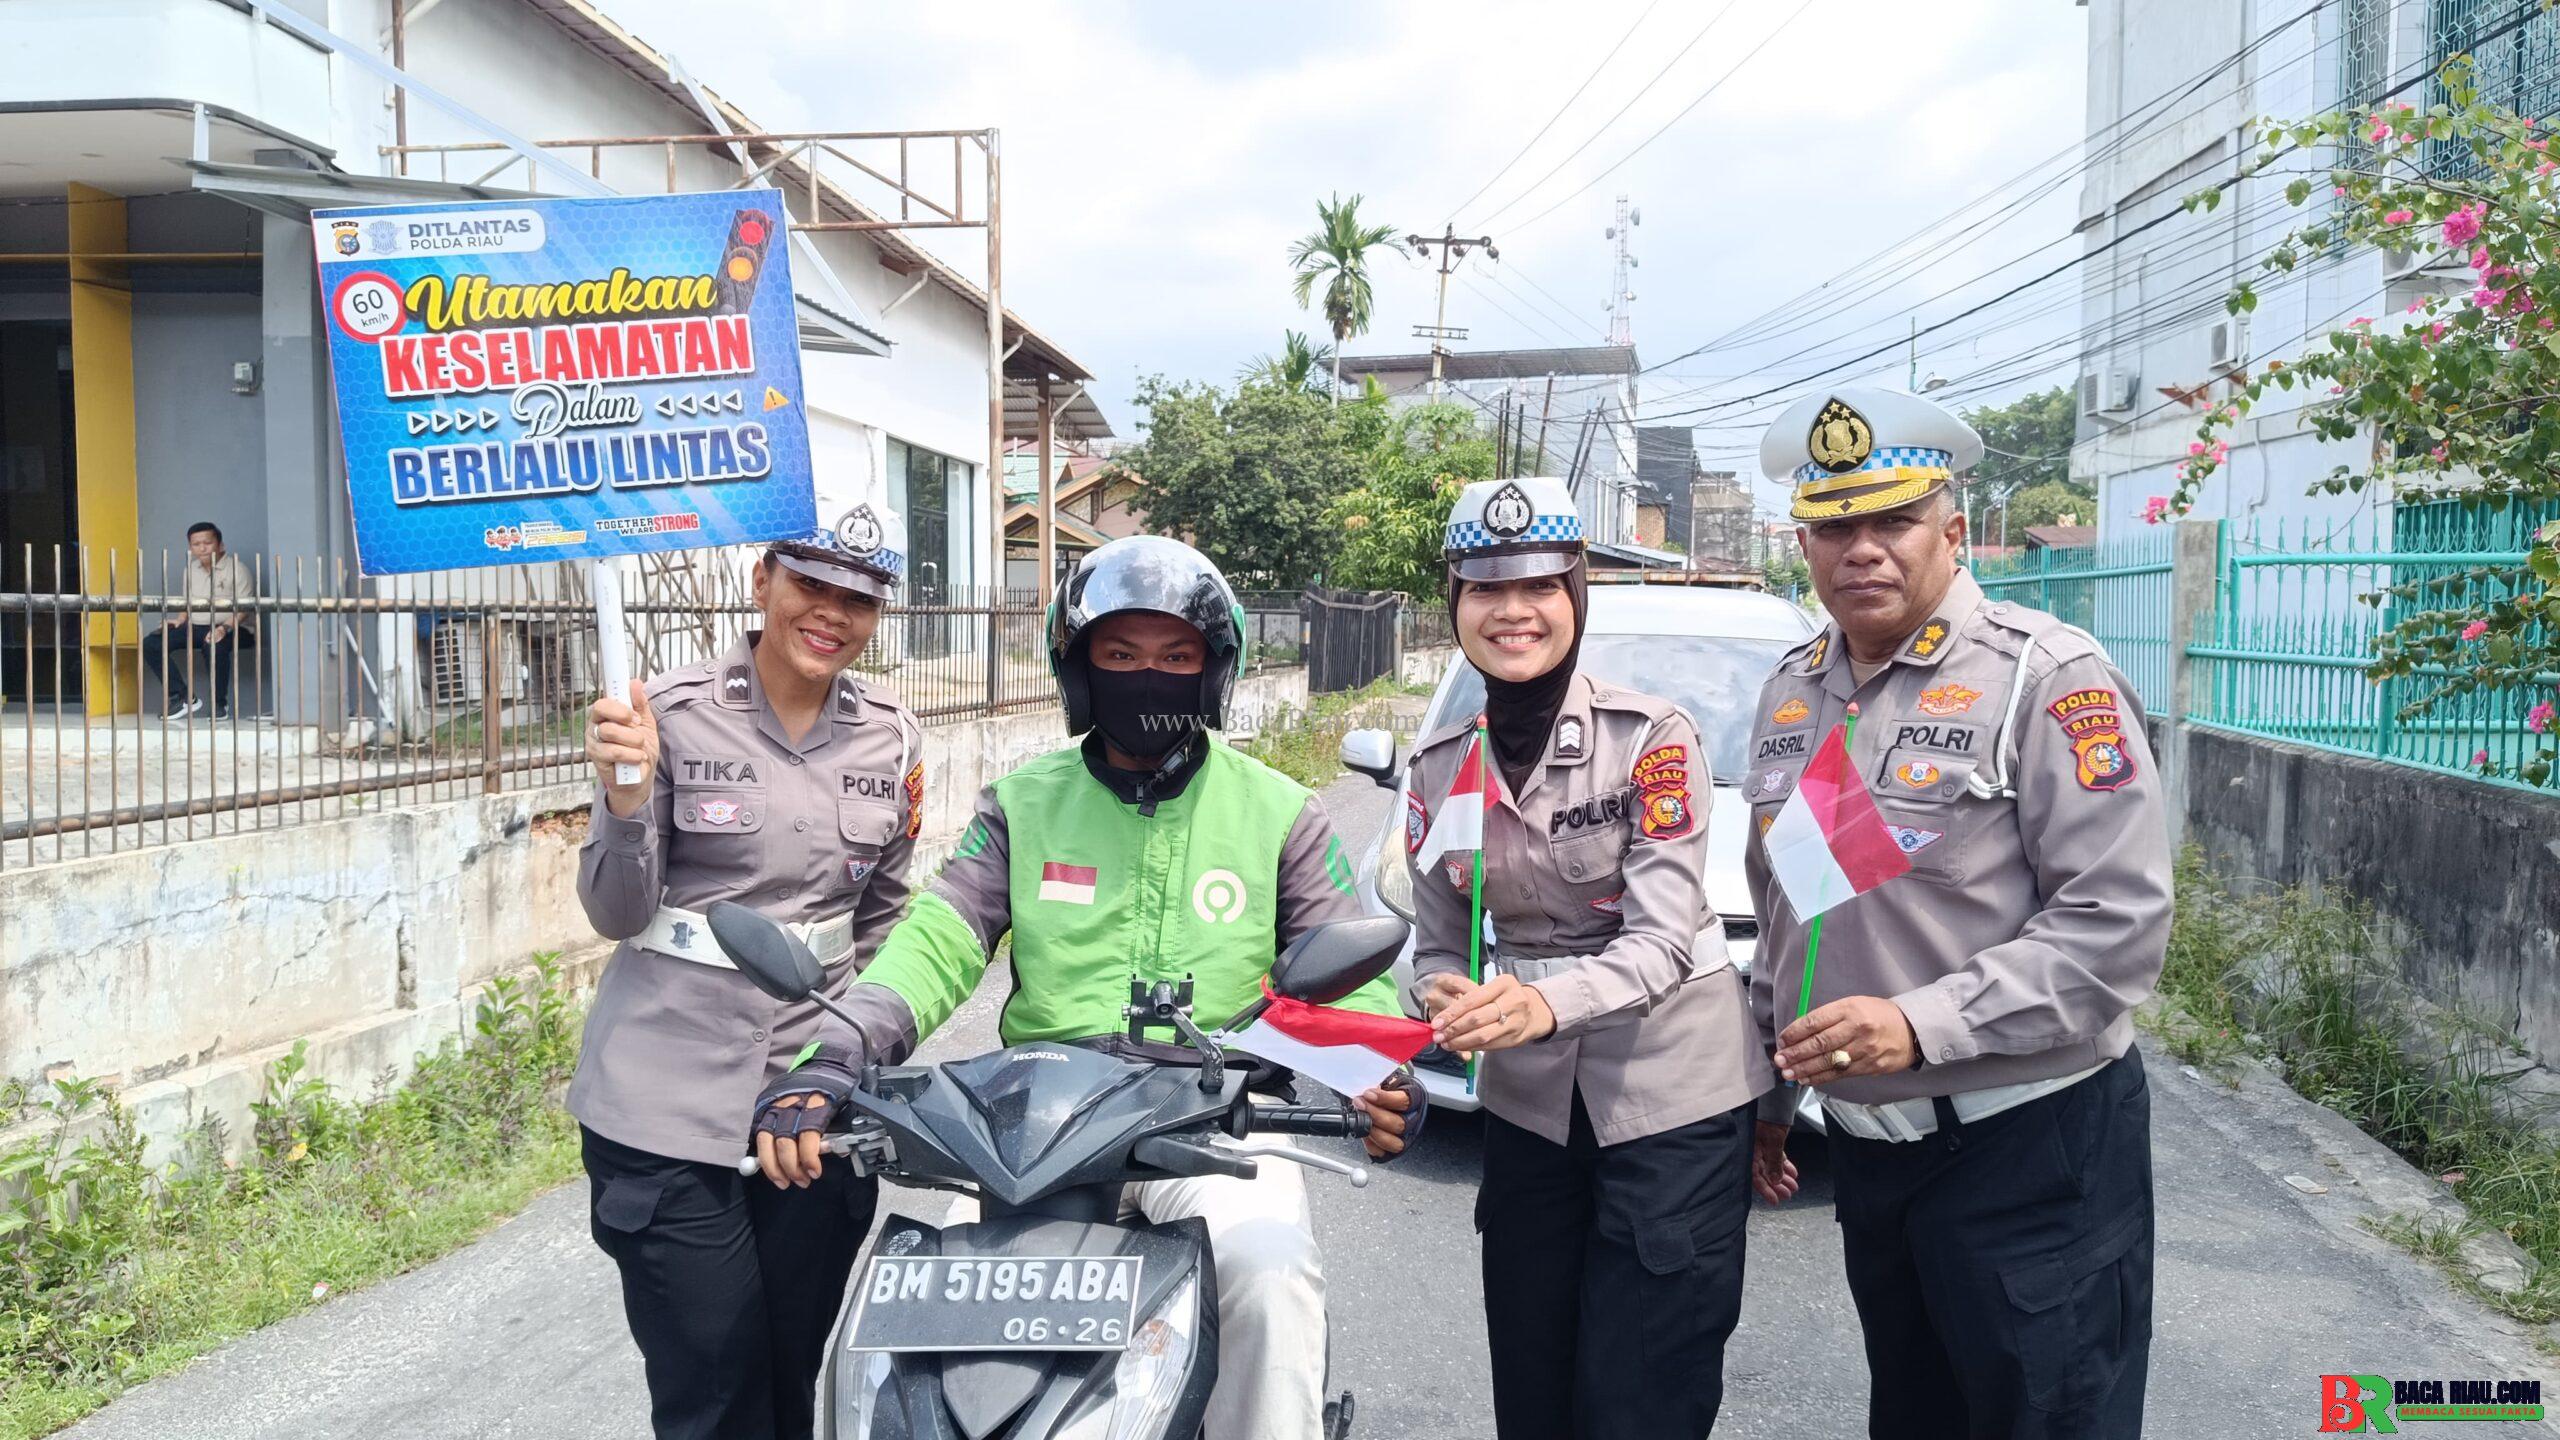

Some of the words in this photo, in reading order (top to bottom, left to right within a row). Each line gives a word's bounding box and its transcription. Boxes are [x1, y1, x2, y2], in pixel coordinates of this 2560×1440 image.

[408, 219, 531, 238] DITLANTAS
[410, 236, 463, 250] POLDA
[467, 236, 504, 247] RIAU
[352, 289, 384, 314] 60
[405, 269, 716, 330] Utamakan
[361, 313, 389, 327] km/h
[383, 317, 753, 395] KESELAMATAN
[514, 383, 640, 440] Dalam
[392, 438, 602, 503] BERLALU
[611, 424, 770, 486] LINTAS
[596, 518, 653, 530] TOGETHER
[654, 514, 699, 531] STRONG
[637, 526, 655, 534] ARE
[2055, 691, 2112, 715] POLDA
[2071, 716, 2114, 732] RIAU
[1758, 733, 1805, 759] DASRIL
[1895, 725, 1974, 752] POLRI
[683, 757, 759, 783] TIKA
[1634, 747, 1683, 779] POLDA
[842, 774, 896, 801] POLRI
[1643, 770, 1682, 785] RIAU
[1551, 791, 1629, 835] POLRI
[1012, 1051, 1070, 1062] HONDA
[871, 1262, 932, 1303] BM
[945, 1262, 1047, 1301] 5195
[1050, 1262, 1128, 1302] ABA
